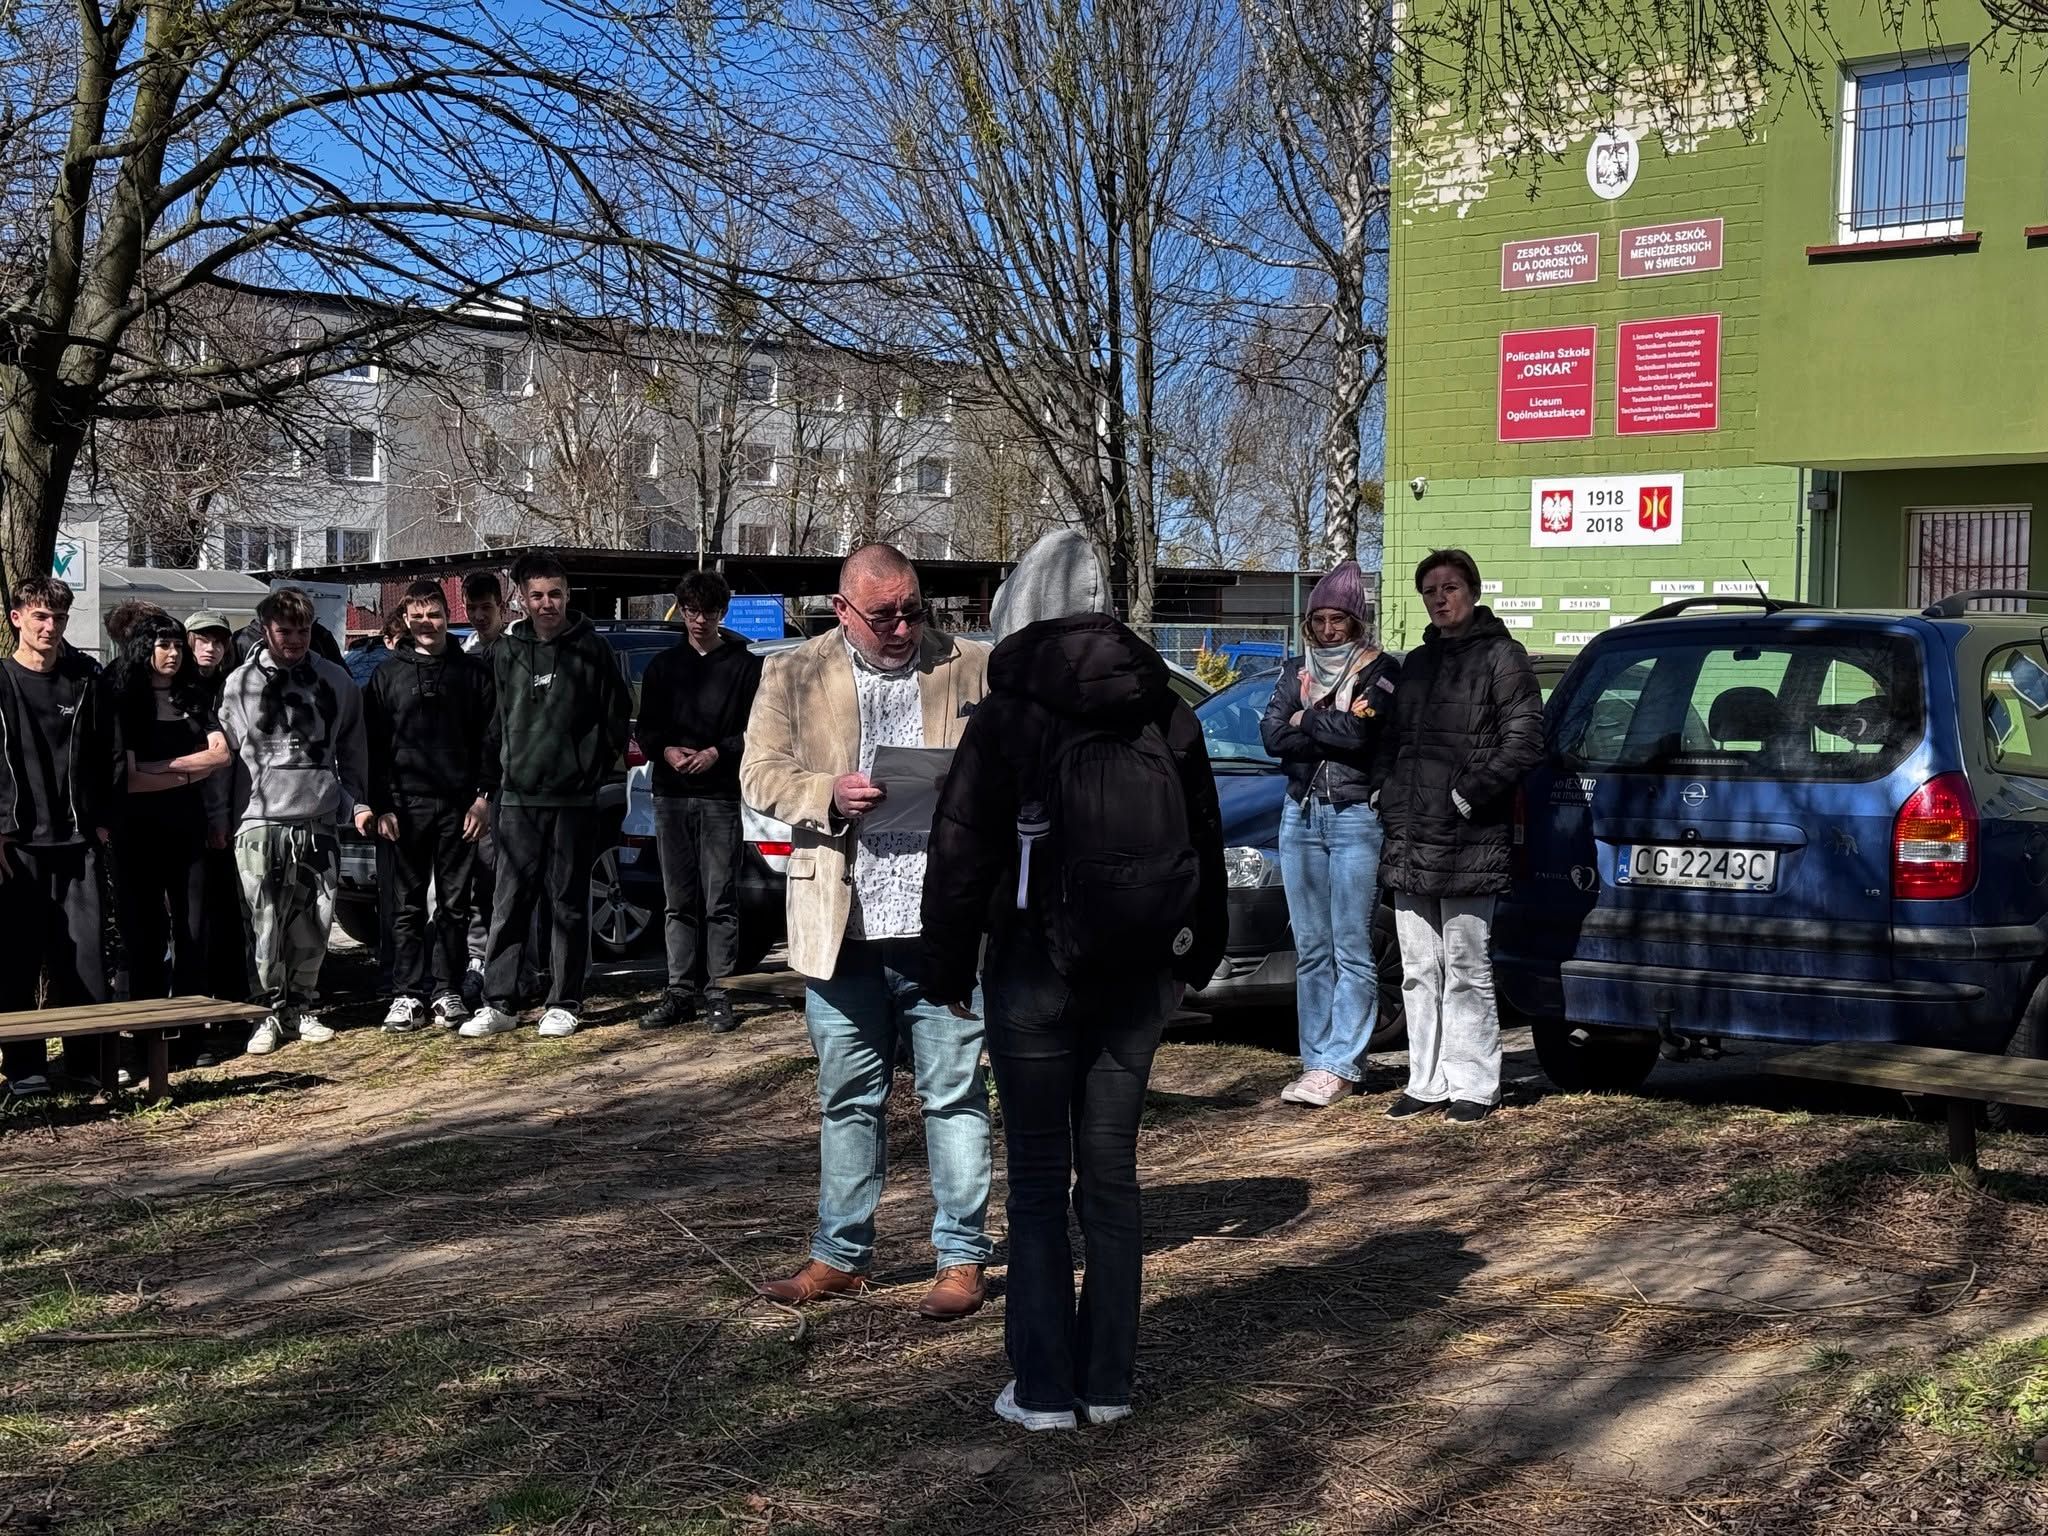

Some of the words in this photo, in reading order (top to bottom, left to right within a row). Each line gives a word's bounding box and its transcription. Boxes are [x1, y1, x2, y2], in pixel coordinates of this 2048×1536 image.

[1635, 233, 1673, 246] ZESPÓŁ
[1674, 227, 1708, 241] SZKÓŁ
[1516, 246, 1552, 259] ZESPÓŁ
[1553, 242, 1585, 255] SZKÓŁ
[1630, 241, 1712, 259] MENEDŻERSKICH
[1512, 260, 1531, 272] DLA
[1532, 254, 1588, 270] DOROSŁYCH
[1644, 260, 1654, 270] W
[1655, 255, 1697, 270] ŚWIECIU
[1525, 272, 1535, 283] W
[1535, 269, 1574, 281] ŚWIECIU
[1632, 333, 1654, 341] Liceum
[1506, 350, 1555, 362] Policealna
[1557, 346, 1590, 358] Szkoła
[1635, 353, 1667, 361] Technikum
[1667, 350, 1700, 358] Informatyki
[1634, 363, 1666, 371] Technikum
[1638, 374, 1669, 382] Technikum
[1670, 371, 1697, 380] Logistyki
[1622, 385, 1652, 393] Technikum
[1529, 397, 1562, 407] Liceum
[1632, 395, 1662, 403] Technikum
[1621, 406, 1652, 414] Technikum
[1683, 402, 1714, 410] Systemów
[1633, 414, 1664, 422] Energetyki
[1587, 490, 1625, 506] 1918
[1586, 517, 1624, 533] 2018
[1569, 600, 1578, 608] 25
[1619, 864, 1629, 872] PL
[1635, 848, 1670, 876] CG
[1679, 850, 1766, 882] 2243C
